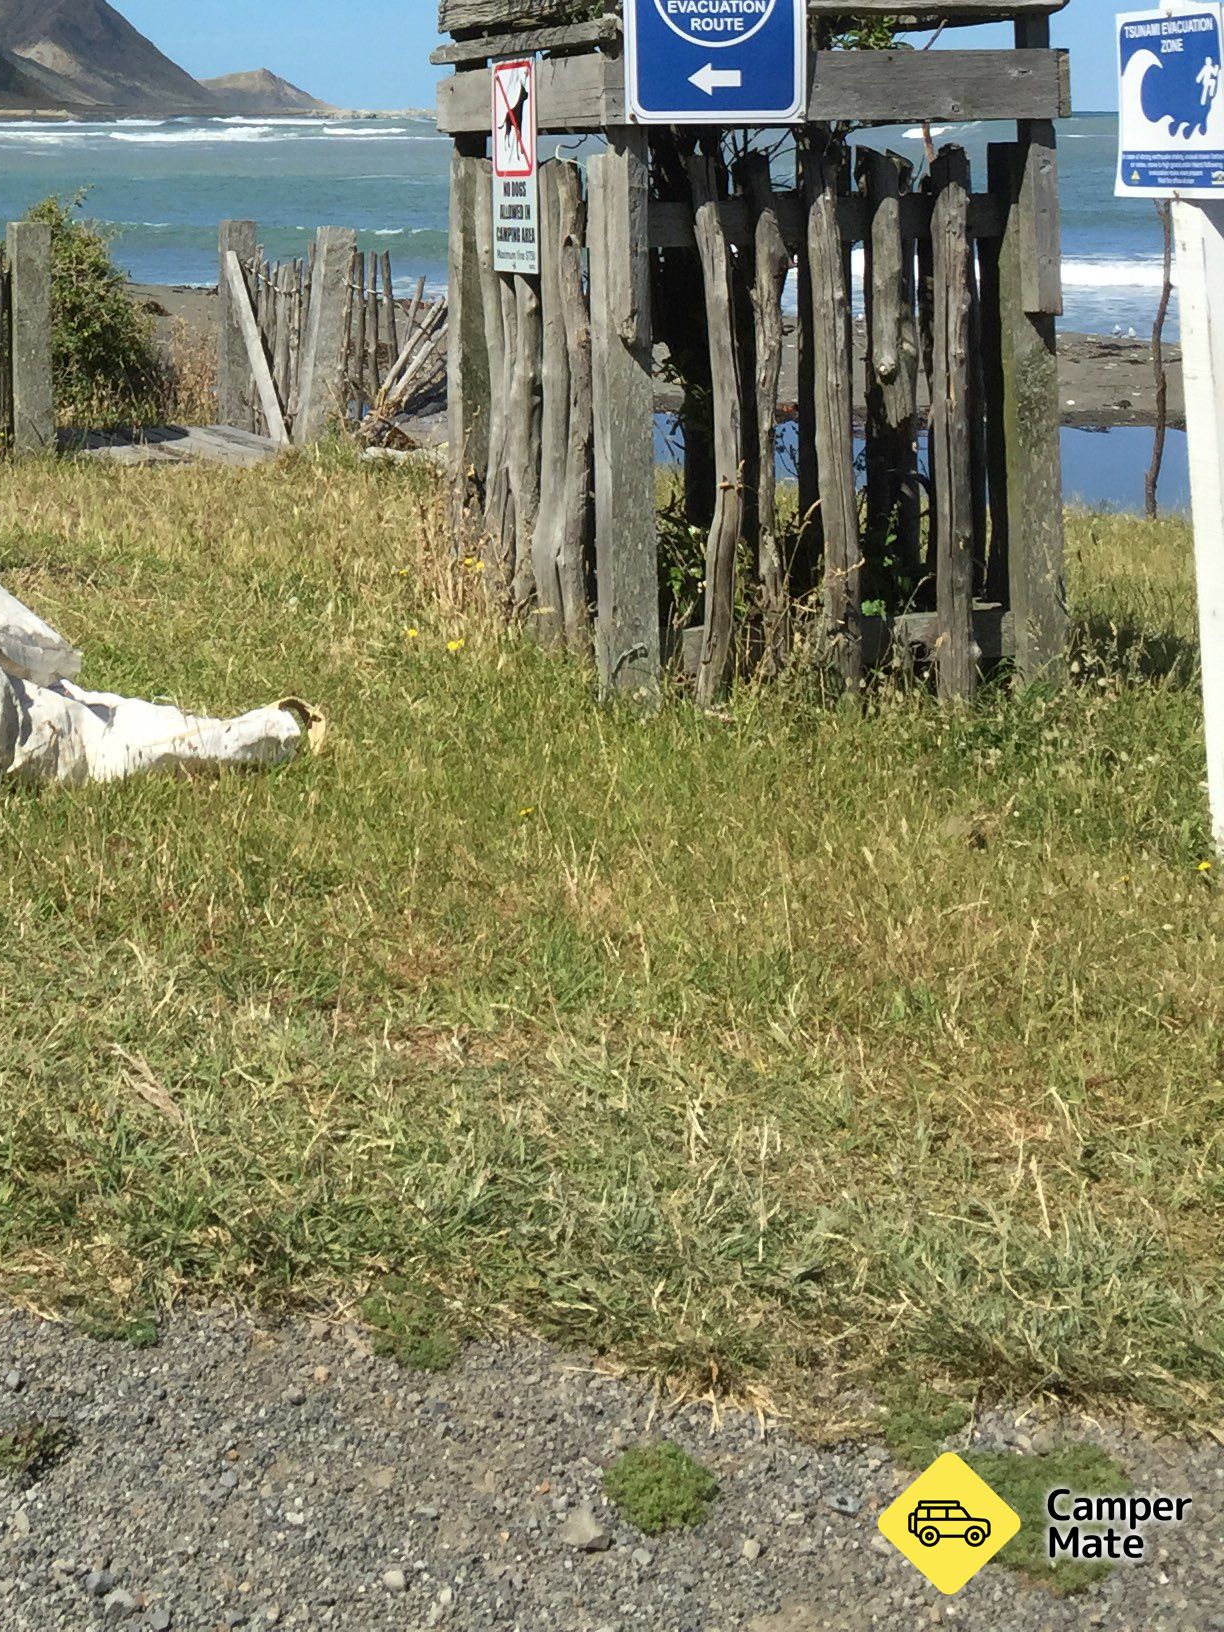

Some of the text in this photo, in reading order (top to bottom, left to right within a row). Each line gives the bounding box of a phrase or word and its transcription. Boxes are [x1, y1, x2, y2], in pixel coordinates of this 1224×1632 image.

[667, 0, 766, 14] EVACUATION
[690, 17, 744, 31] ROUTE
[1124, 17, 1214, 39] TSUNAMI EVACUATION
[1160, 38, 1184, 53] ZONE
[503, 181, 526, 197] NO DOGS
[499, 204, 524, 220] ALLOWED
[496, 226, 536, 244] CAMPING AREA
